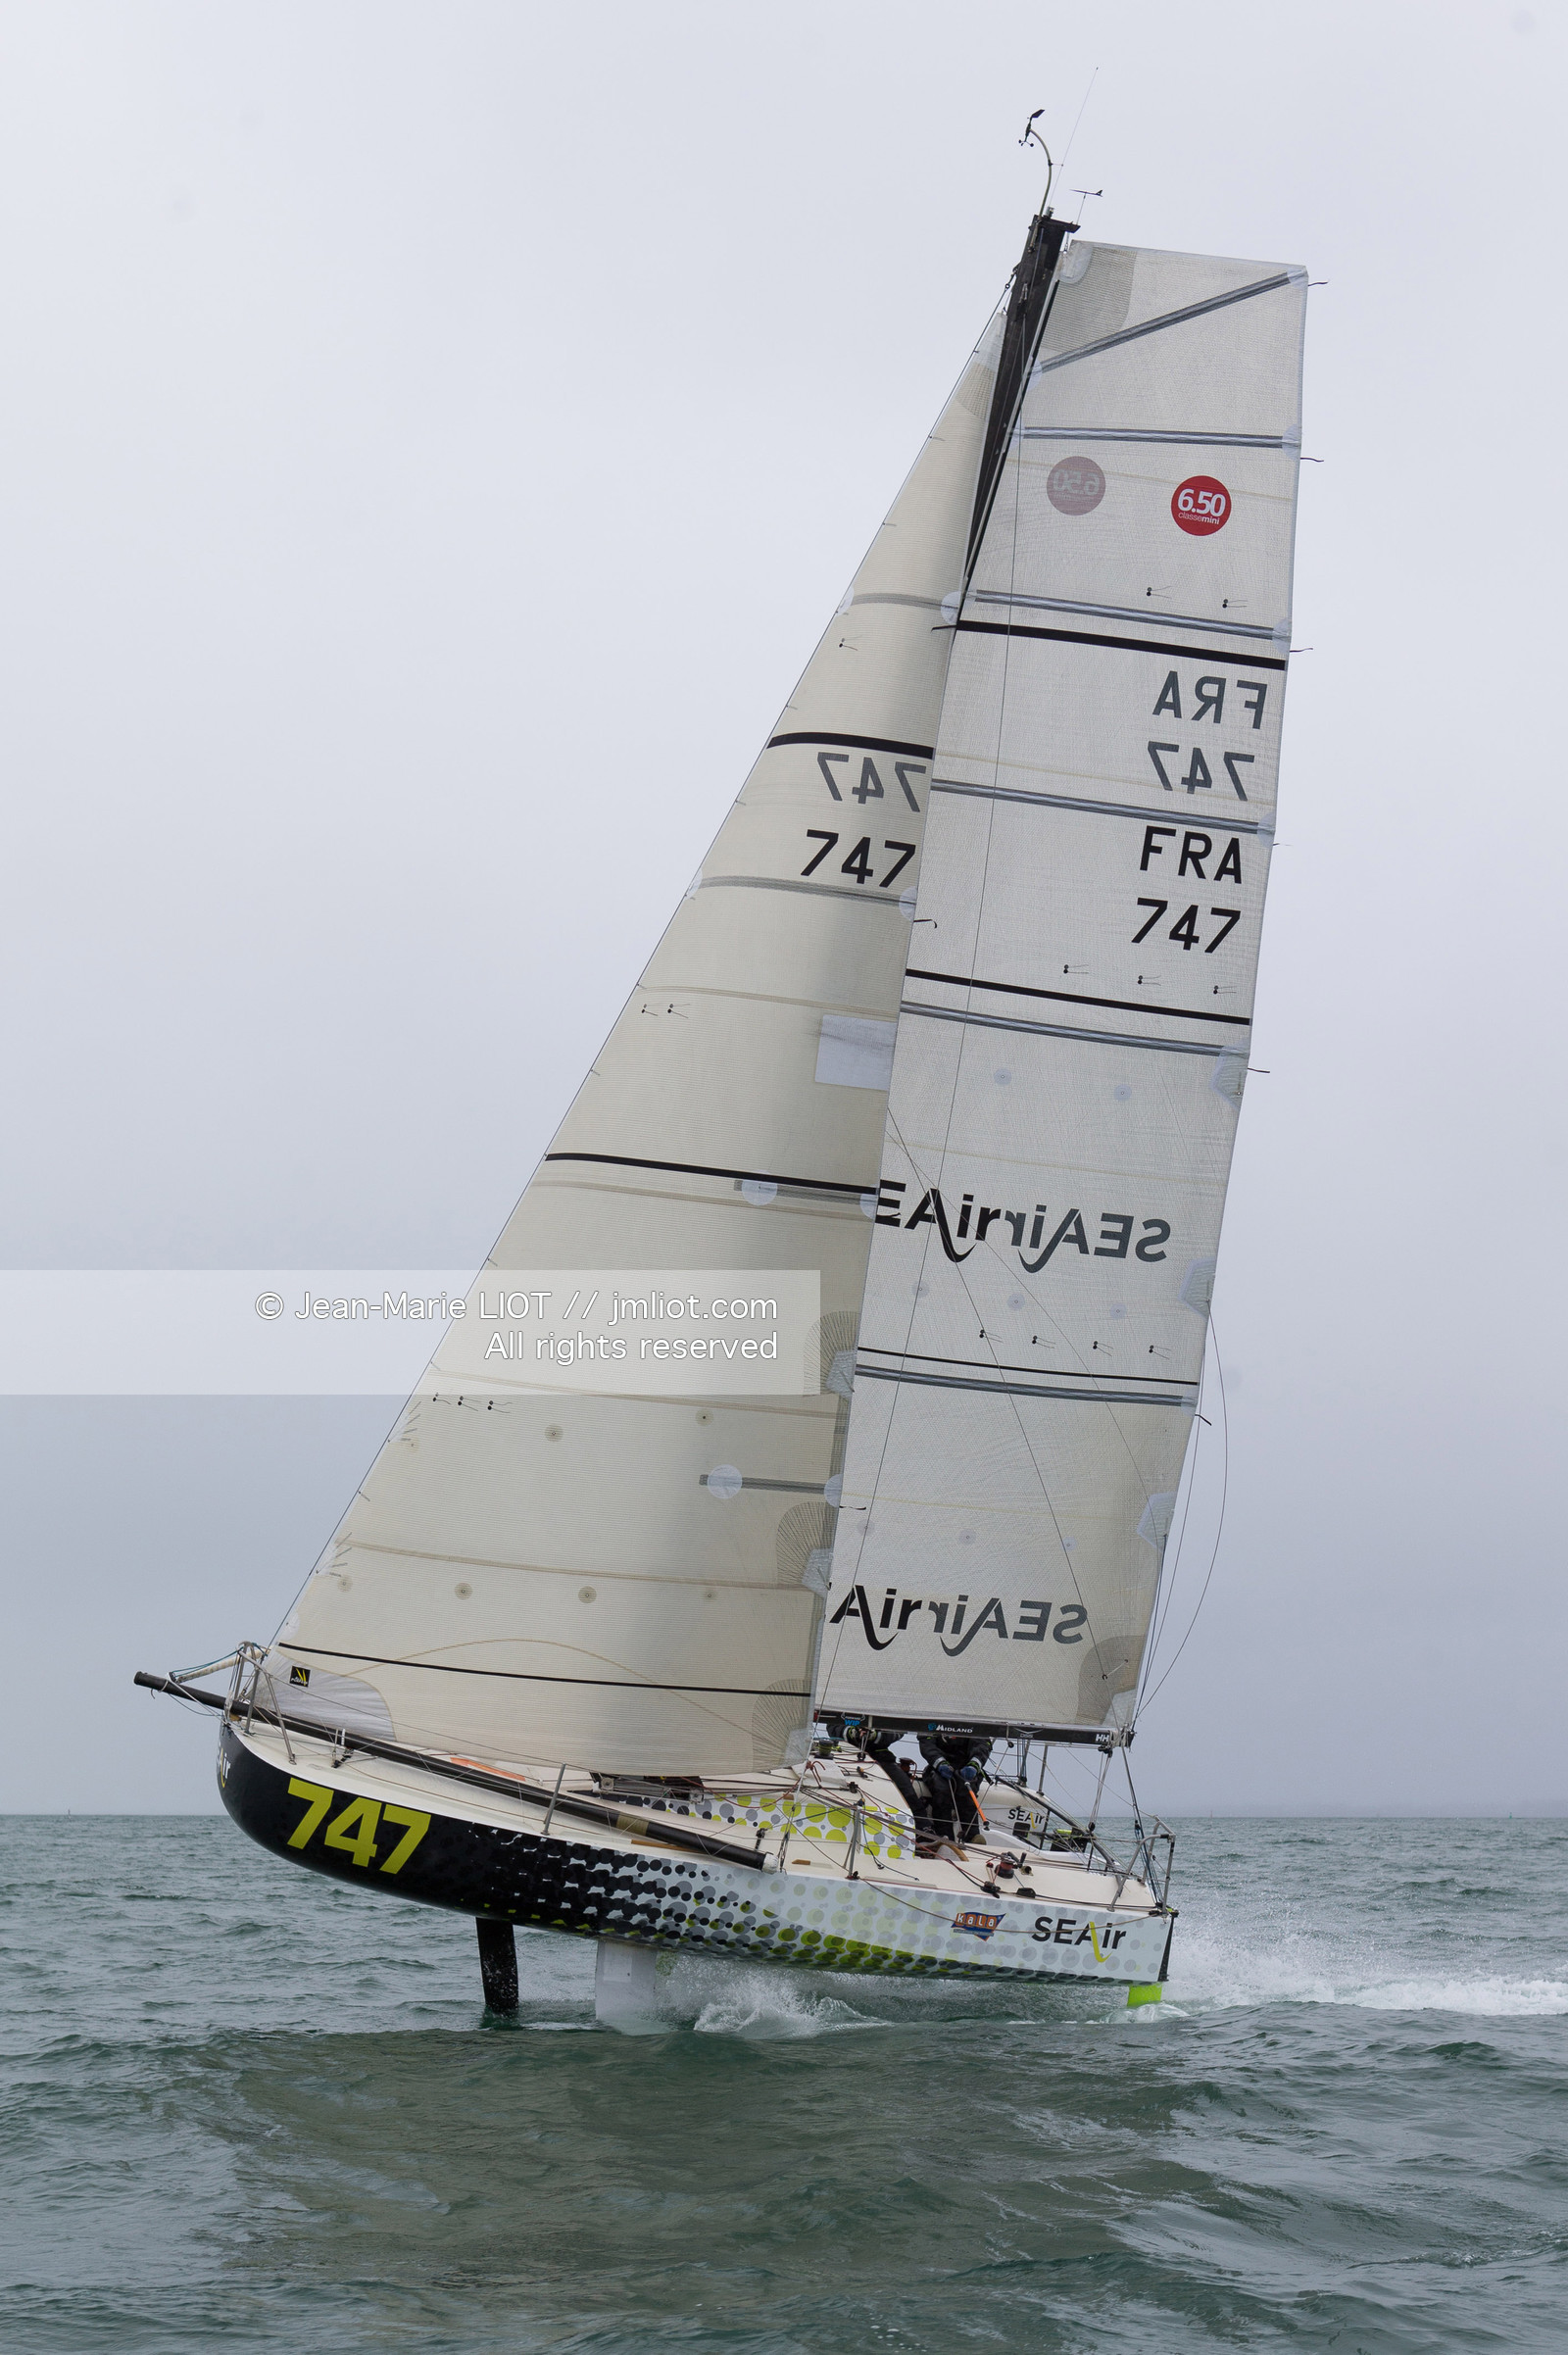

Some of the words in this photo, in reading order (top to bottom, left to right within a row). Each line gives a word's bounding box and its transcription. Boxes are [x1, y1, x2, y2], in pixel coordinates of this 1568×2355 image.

[1177, 488, 1226, 516] 6.50
[800, 829, 917, 888] 747
[1139, 825, 1243, 884] FRA
[1131, 897, 1242, 954] 747
[874, 1179, 1002, 1263] EAir
[829, 1584, 923, 1651] Air
[936, 1724, 973, 1734] MIDLAND
[286, 1777, 432, 1875] 747
[1007, 1808, 1045, 1830] SEAir
[1031, 1916, 1126, 1963] SEAir
